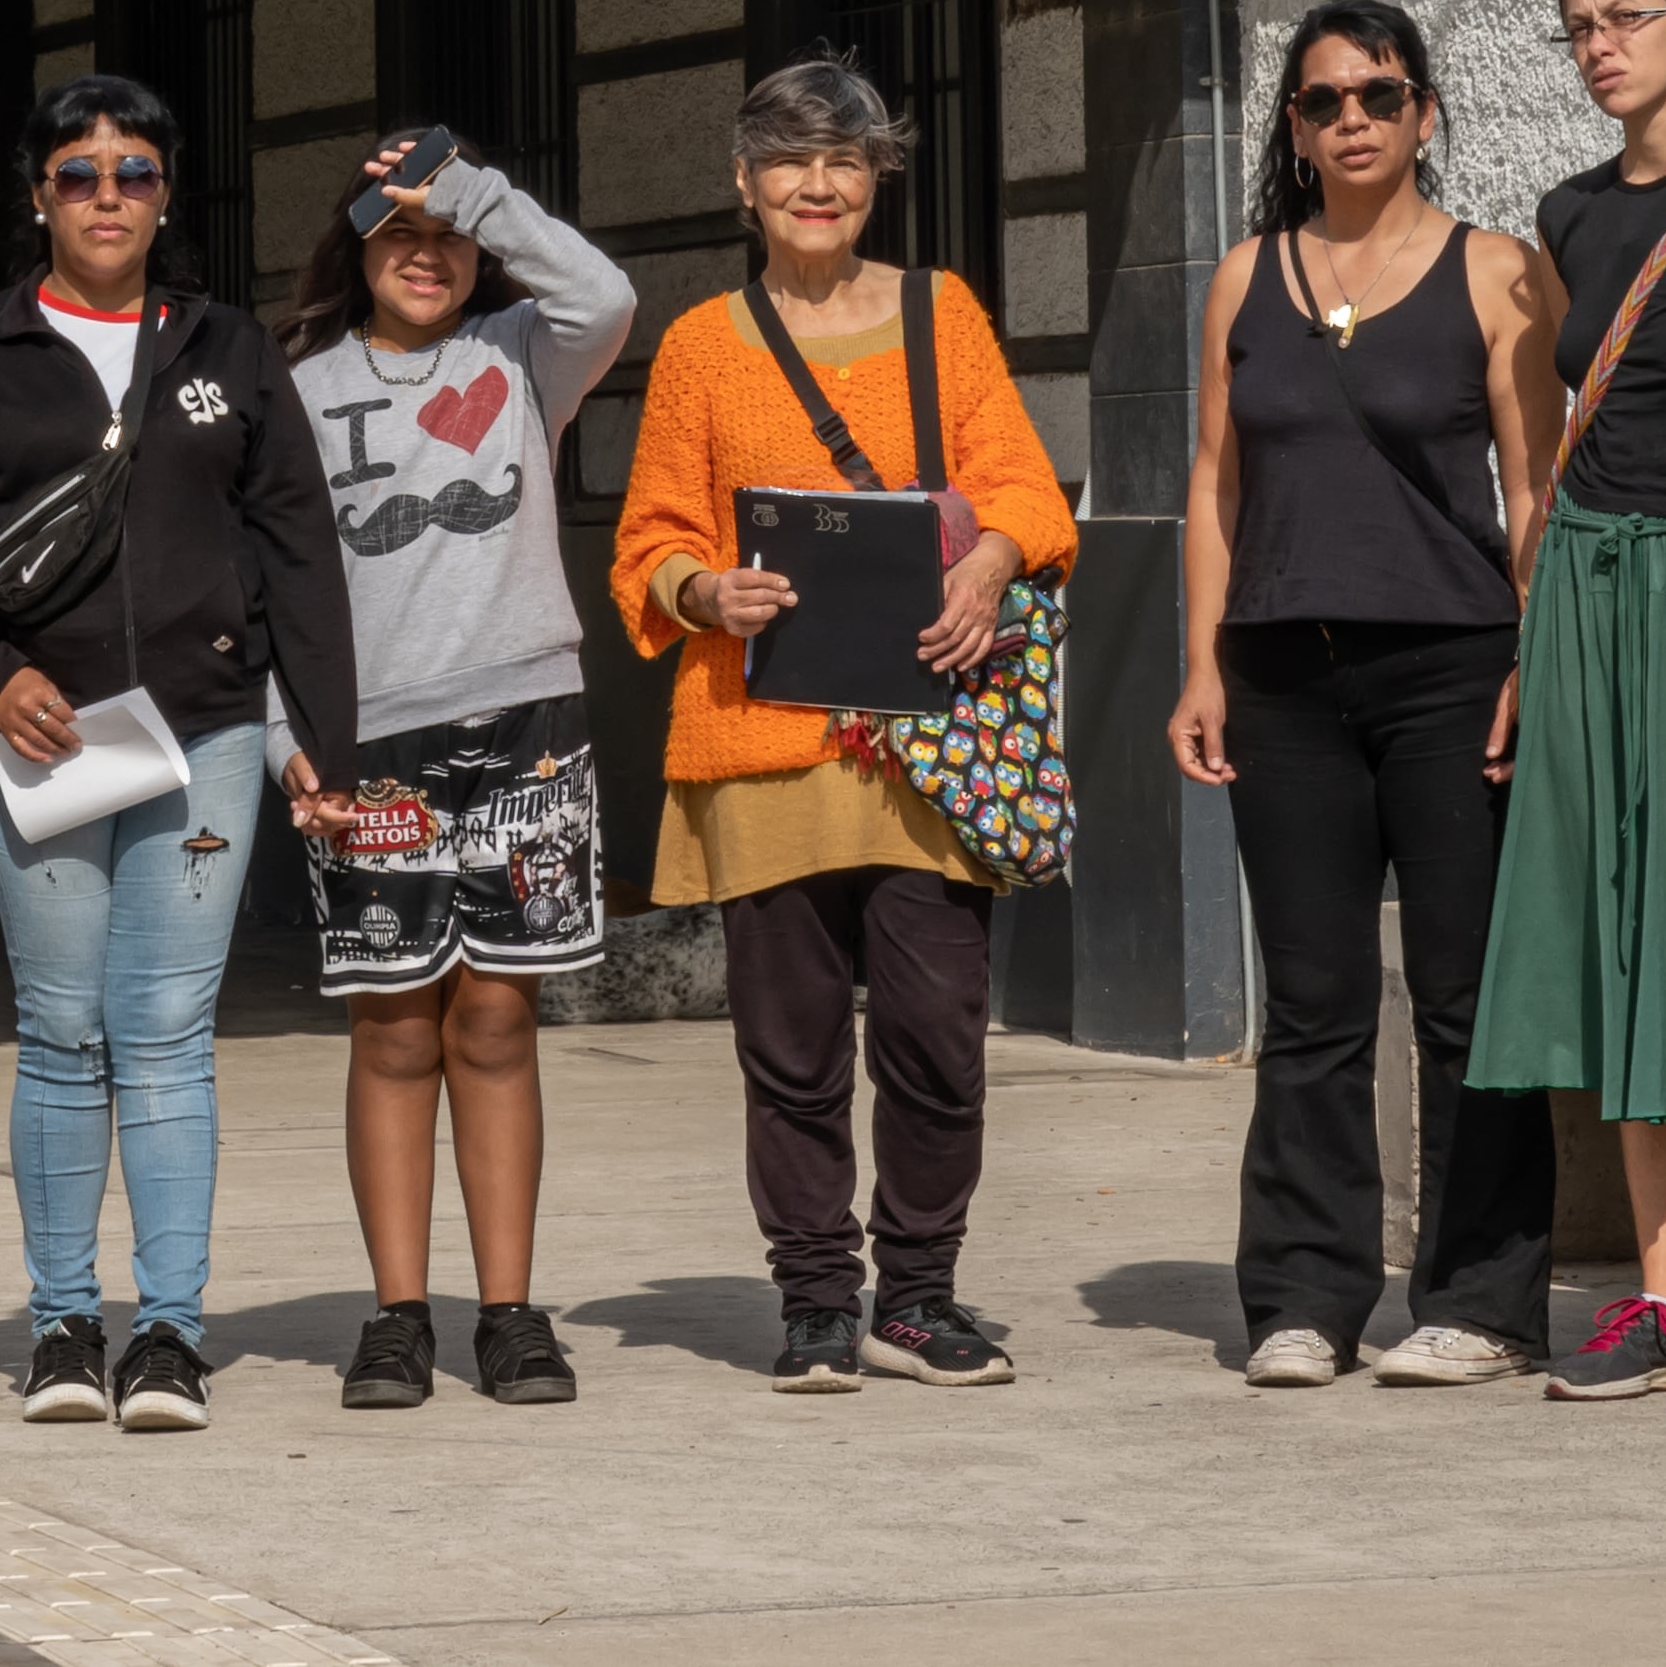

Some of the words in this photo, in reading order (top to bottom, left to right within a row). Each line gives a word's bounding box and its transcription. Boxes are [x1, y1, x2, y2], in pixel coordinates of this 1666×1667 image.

[321, 397, 397, 490] I
[349, 809, 419, 829] TELLA
[346, 825, 421, 847] ARTOIS
